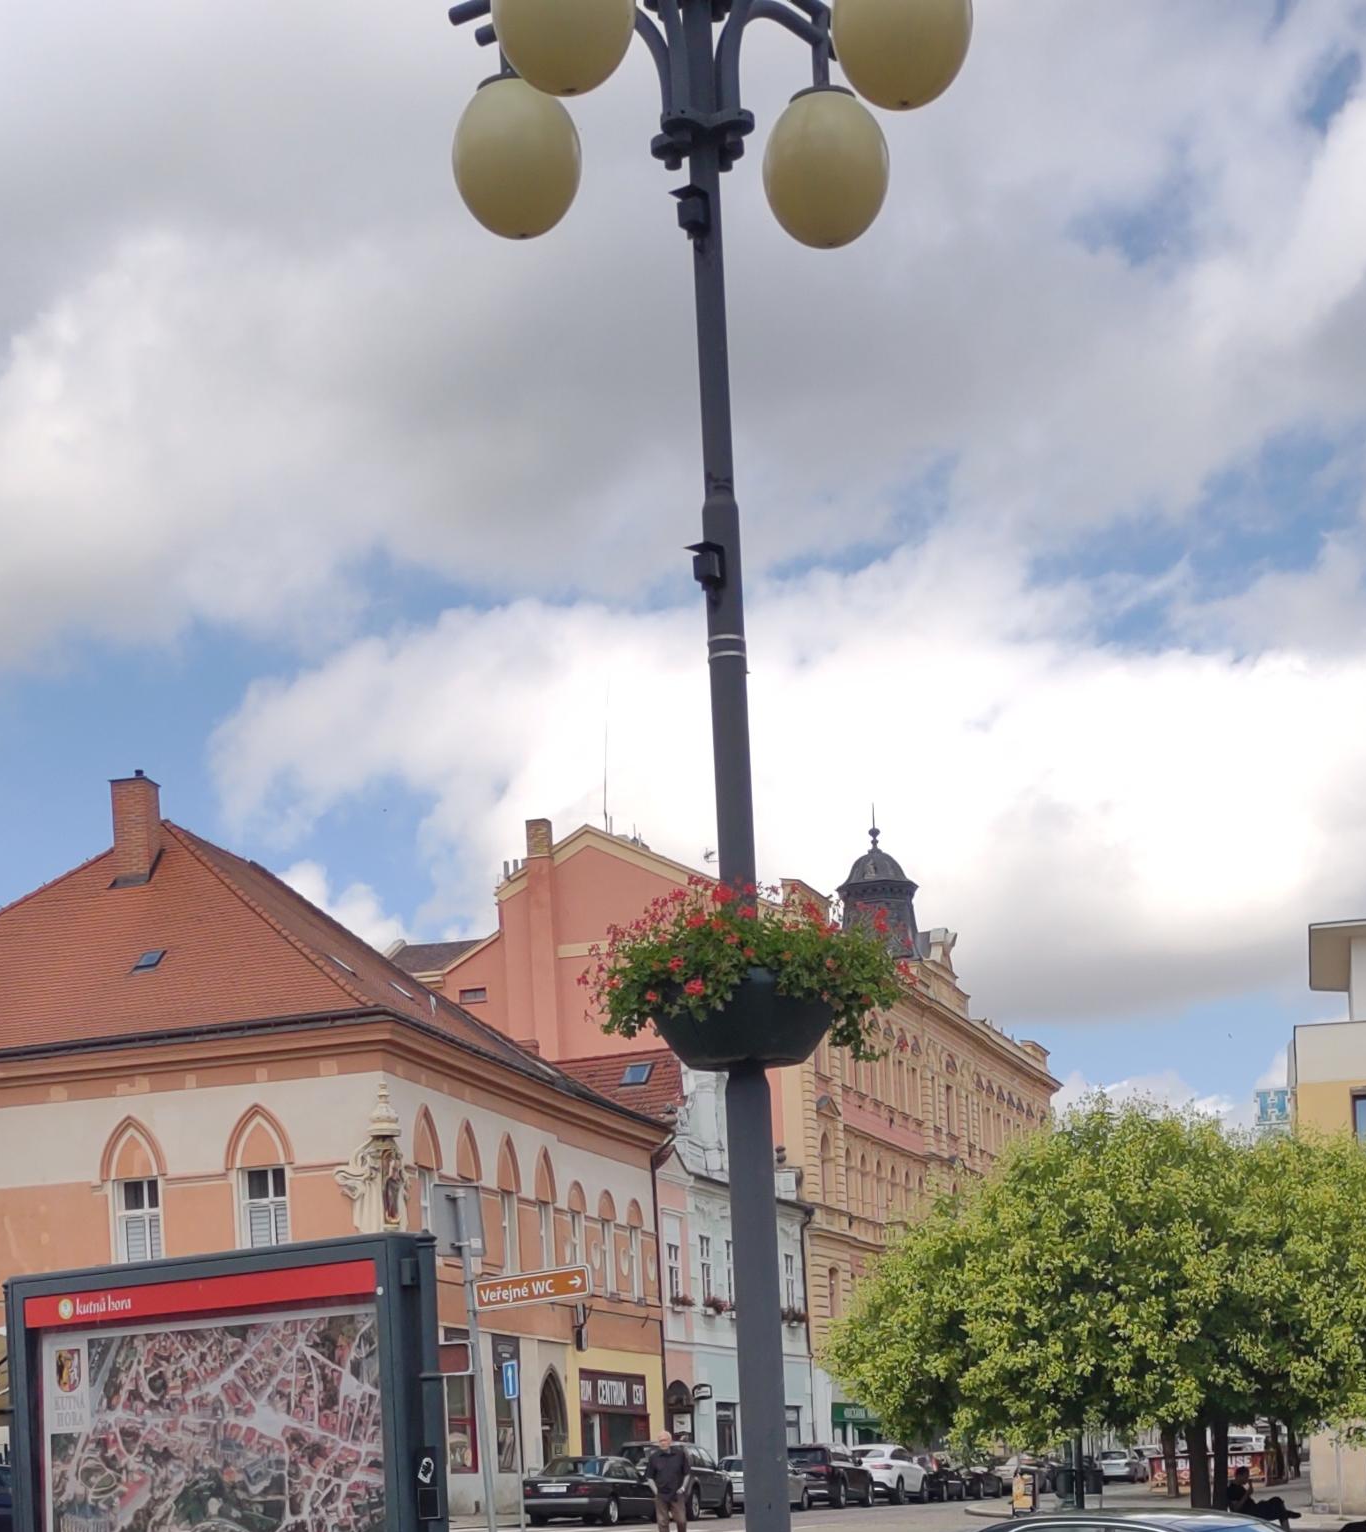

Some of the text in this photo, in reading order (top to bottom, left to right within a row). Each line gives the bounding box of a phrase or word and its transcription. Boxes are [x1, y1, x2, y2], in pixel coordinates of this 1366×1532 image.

[480, 1279, 554, 1302] Veřejné WC
[597, 1379, 627, 1406] CENTRUM
